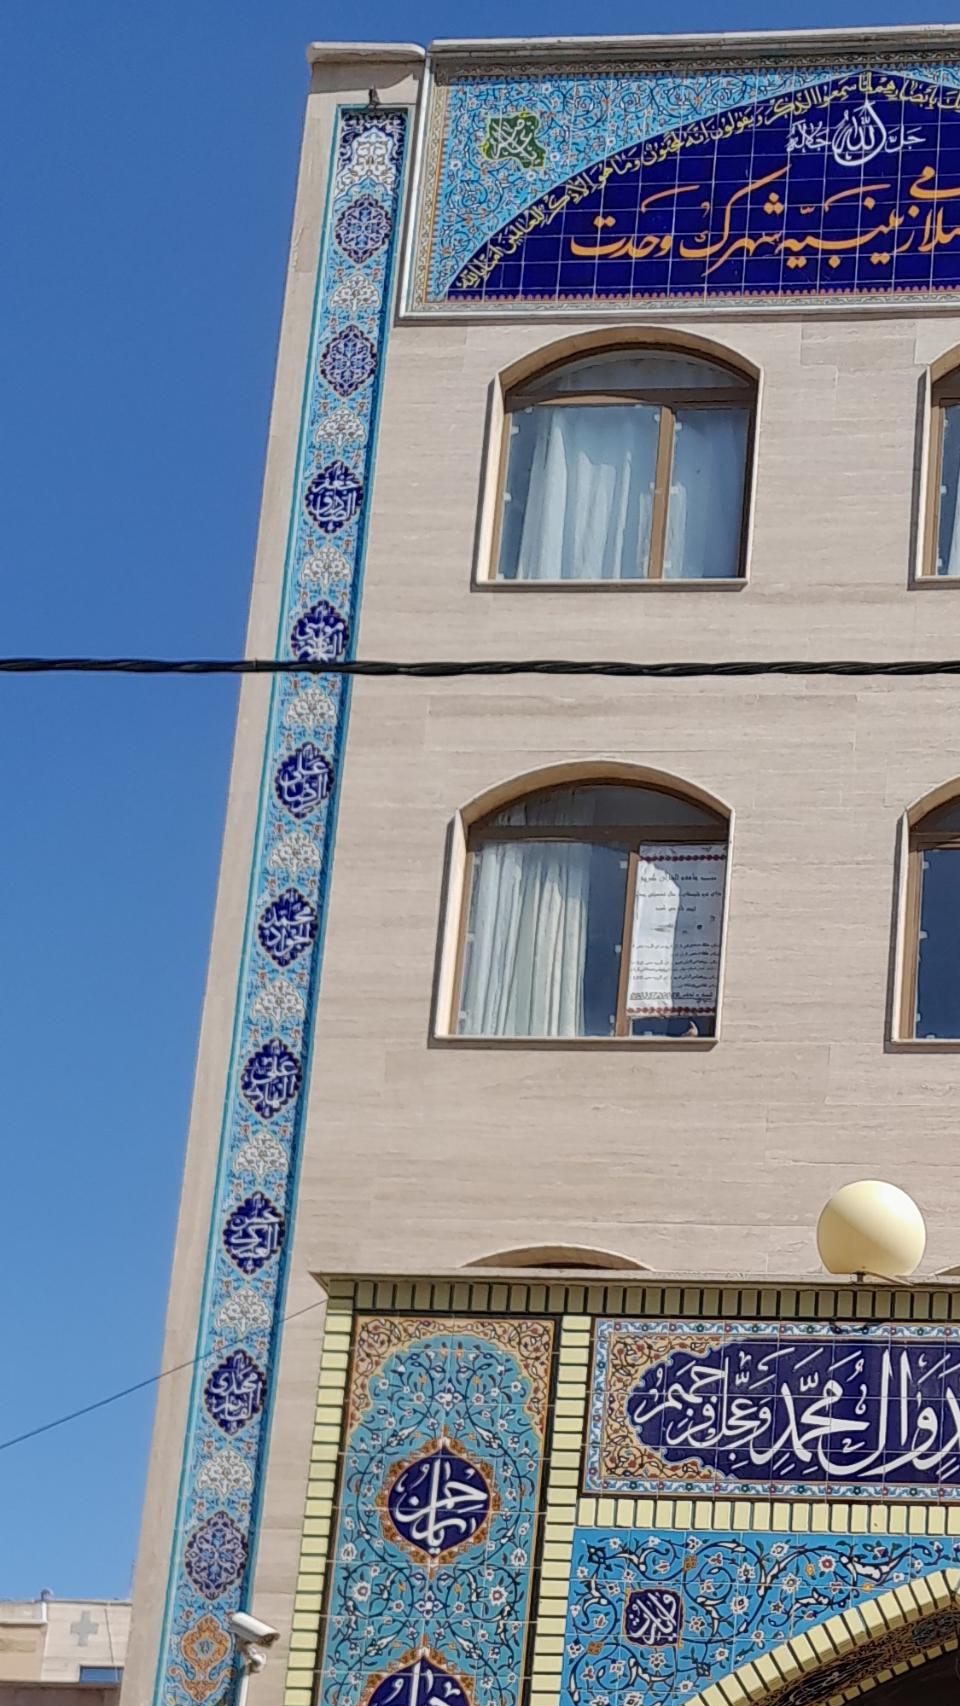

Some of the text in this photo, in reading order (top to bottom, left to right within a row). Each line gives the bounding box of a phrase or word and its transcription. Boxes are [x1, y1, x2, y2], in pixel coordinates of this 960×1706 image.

[832, 98, 886, 166] الله
[571, 212, 674, 259] وحدت
[679, 164, 792, 278] شهرک
[634, 1360, 726, 1447] فرجهم
[750, 1378, 871, 1466] محمد
